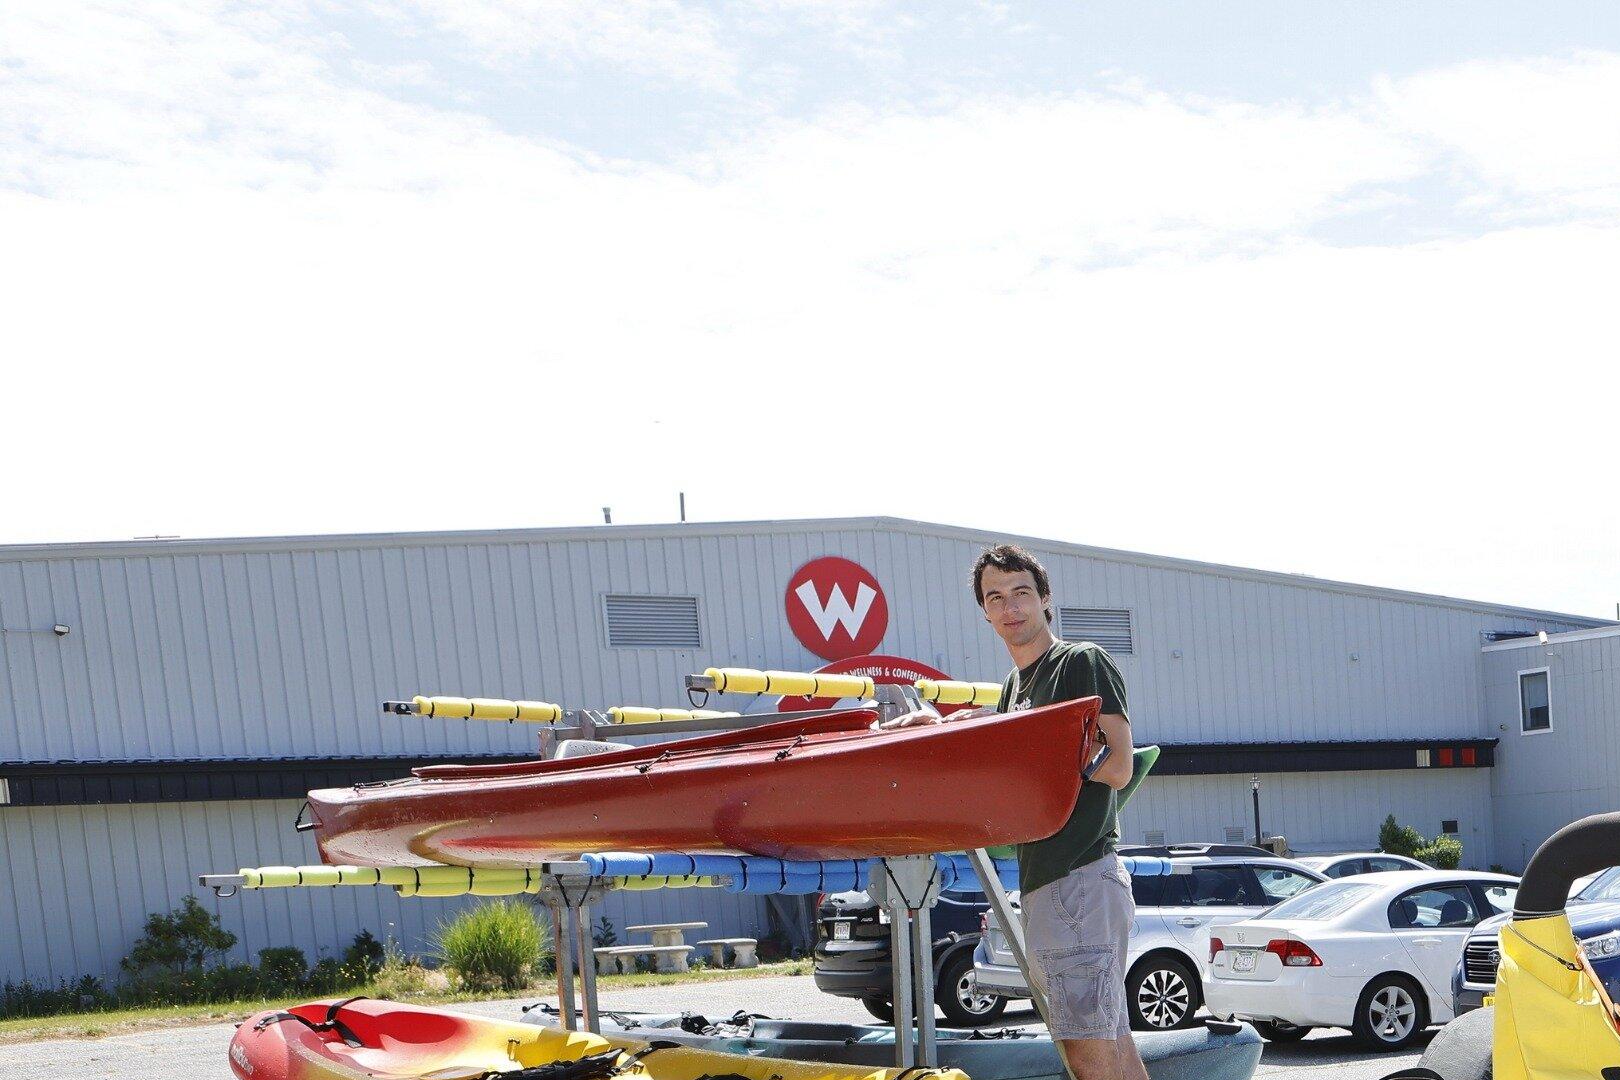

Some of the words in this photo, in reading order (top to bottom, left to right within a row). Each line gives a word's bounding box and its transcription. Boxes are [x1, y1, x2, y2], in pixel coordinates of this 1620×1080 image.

[795, 579, 877, 642] W
[850, 667, 882, 677] WELLNESS
[885, 667, 890, 677] &
